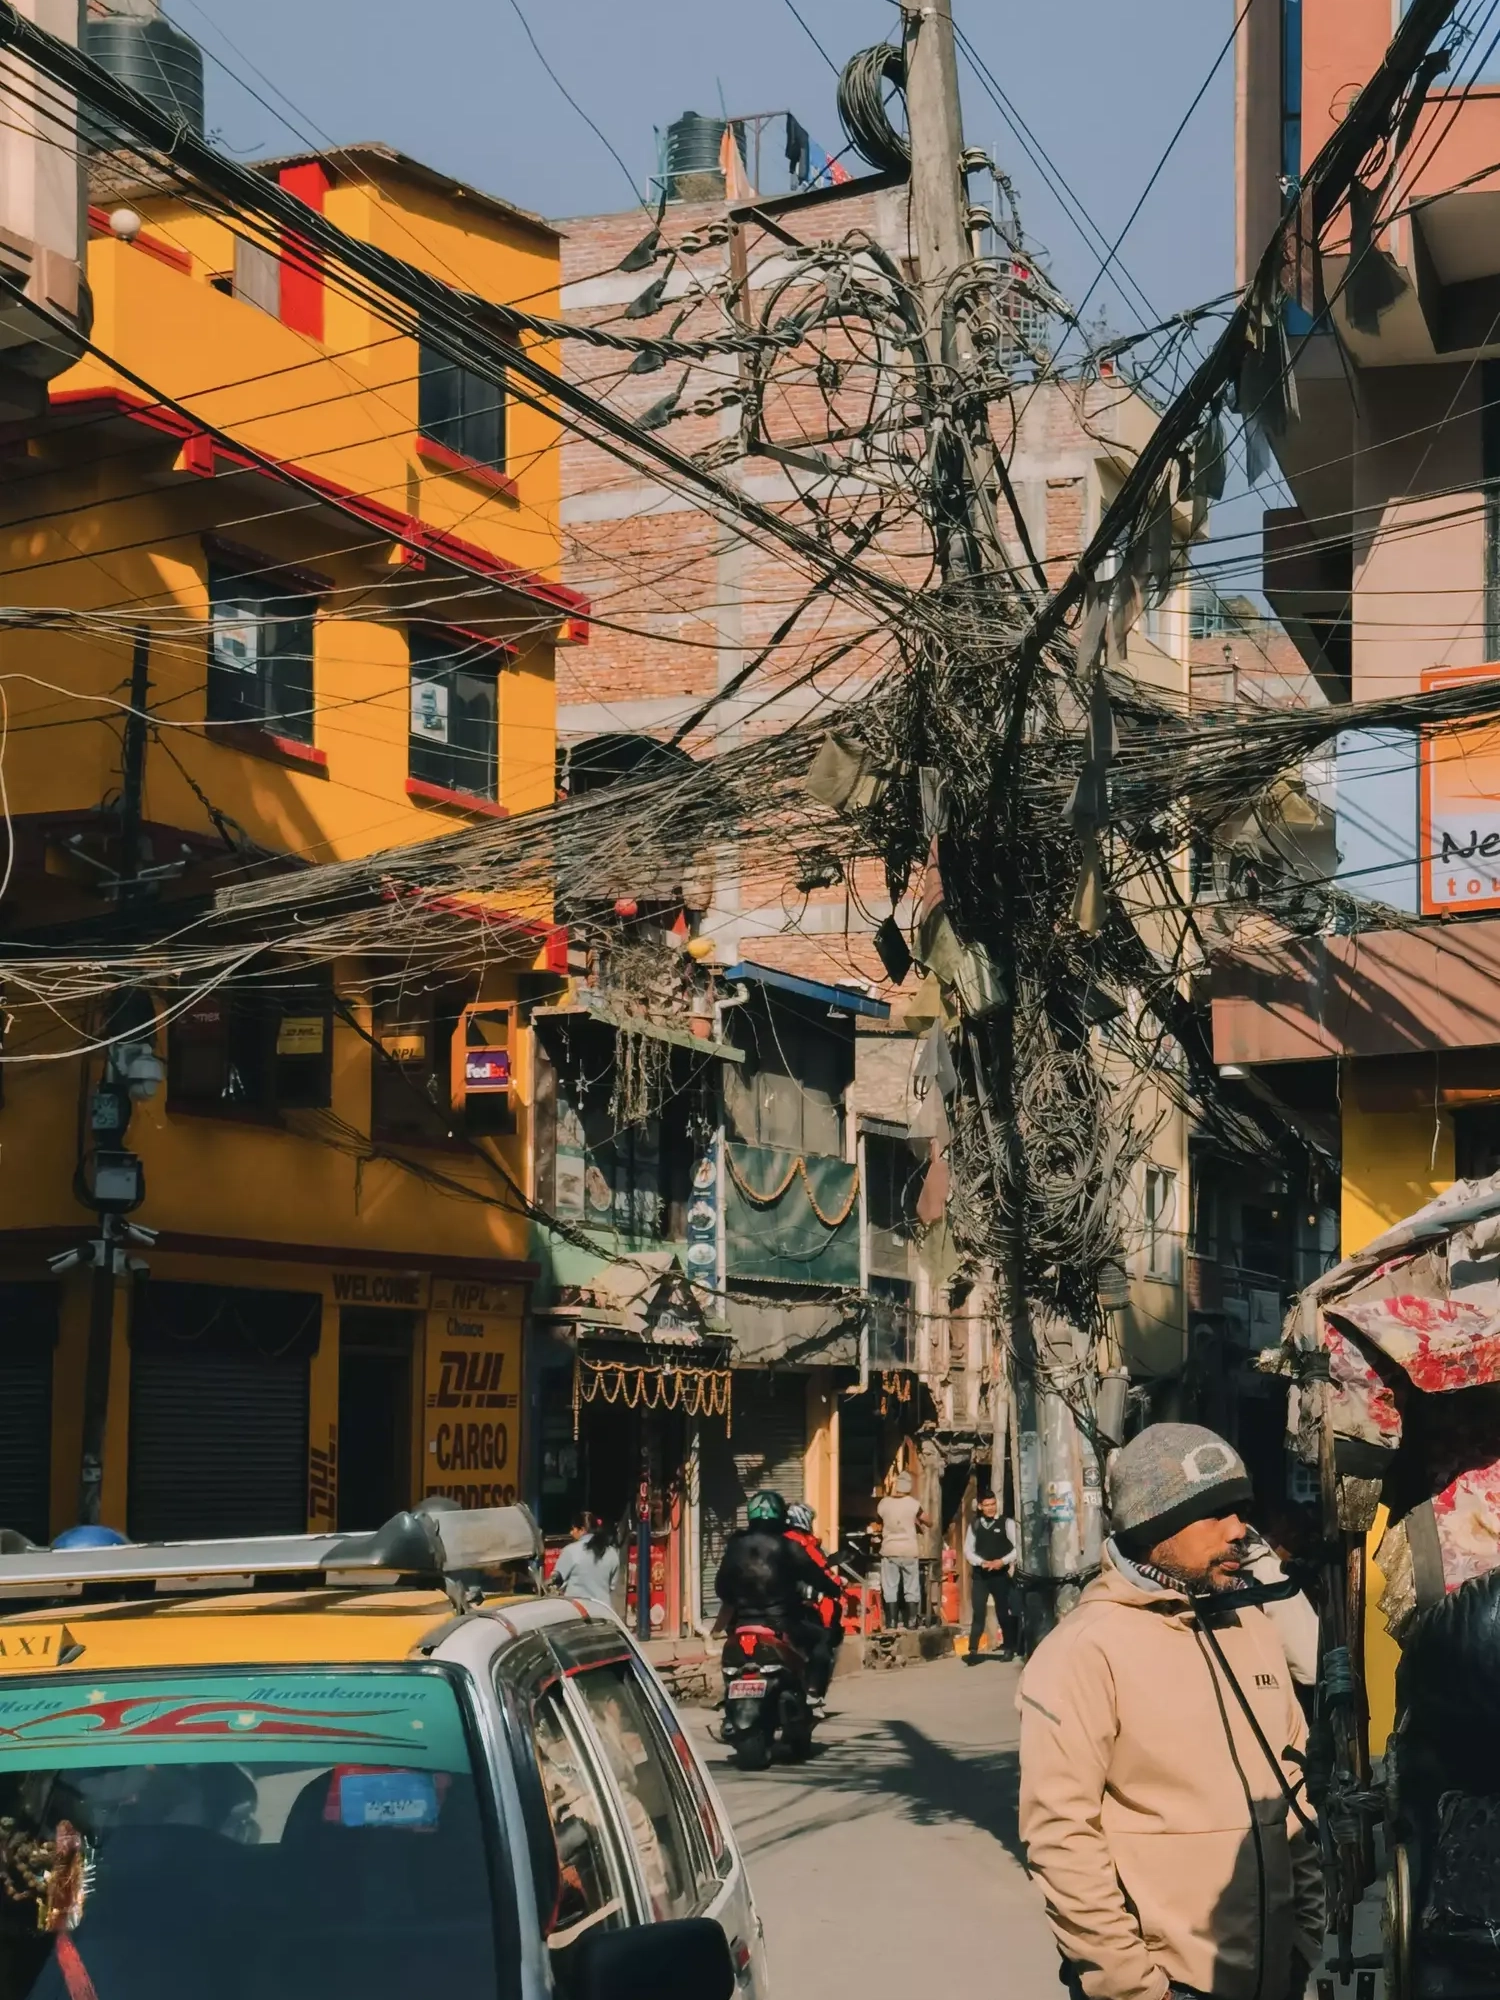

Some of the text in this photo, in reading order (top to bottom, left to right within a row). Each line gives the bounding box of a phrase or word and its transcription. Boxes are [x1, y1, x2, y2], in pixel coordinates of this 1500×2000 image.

[333, 1274, 420, 1304] WELCOME
[452, 1286, 489, 1310] NPL
[432, 1350, 512, 1409] DHL
[436, 1422, 508, 1471] CARGO
[309, 1434, 337, 1519] DHL
